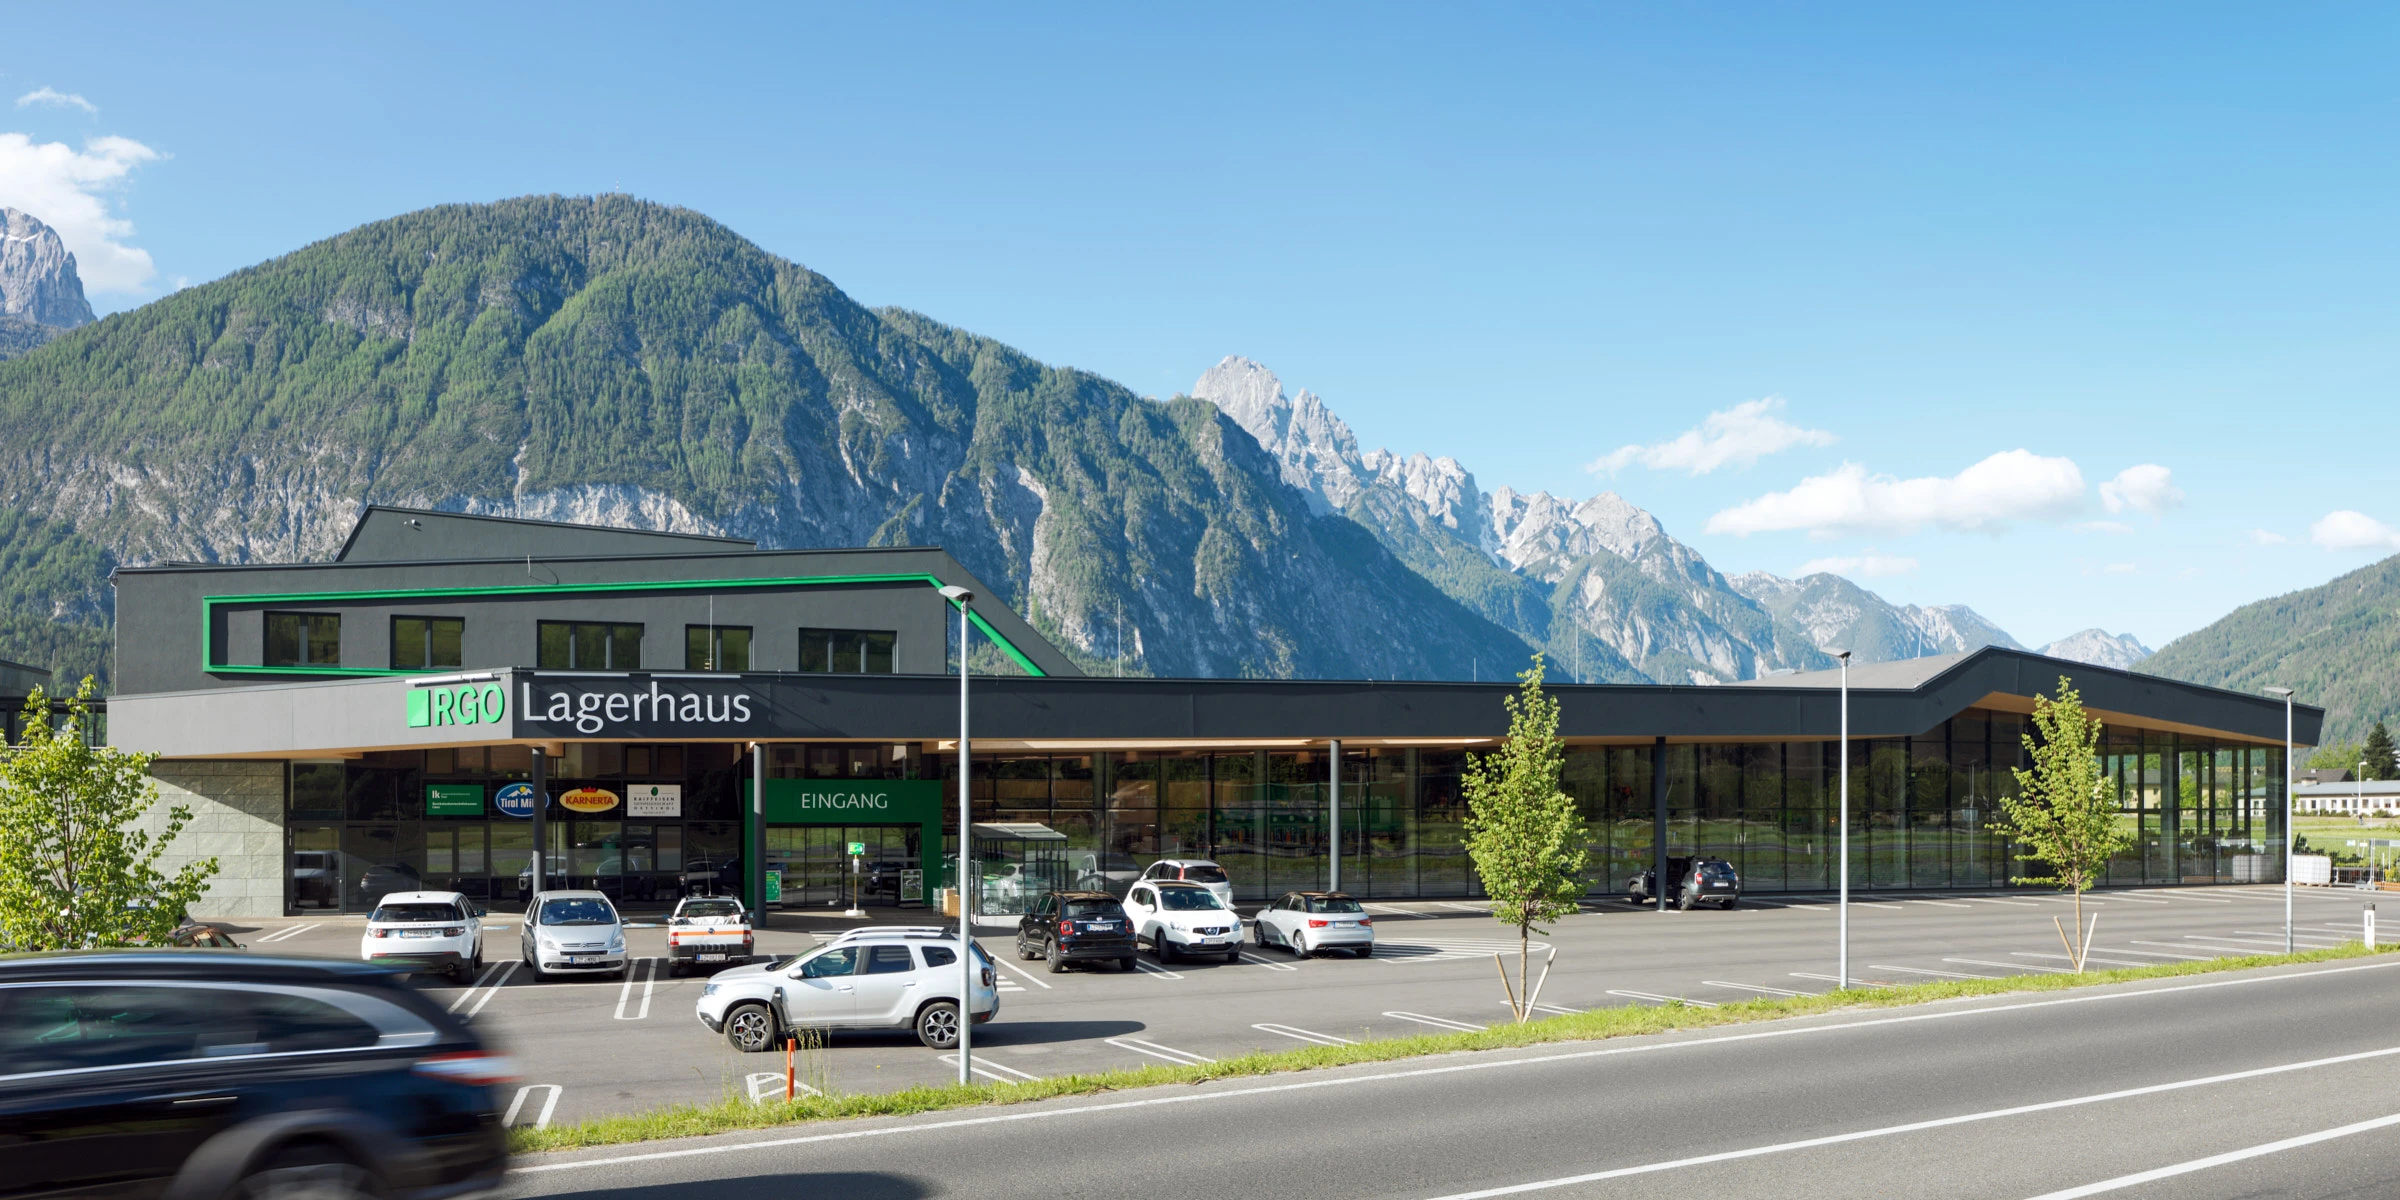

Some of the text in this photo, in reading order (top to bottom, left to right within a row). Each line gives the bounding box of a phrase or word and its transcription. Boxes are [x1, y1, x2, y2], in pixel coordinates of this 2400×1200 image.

[434, 683, 504, 726] RGO
[523, 681, 751, 733] Lagerhaus
[500, 798, 534, 808] Tirol Mil
[565, 795, 614, 805] KARNERTA
[801, 793, 888, 809] EINGANG
